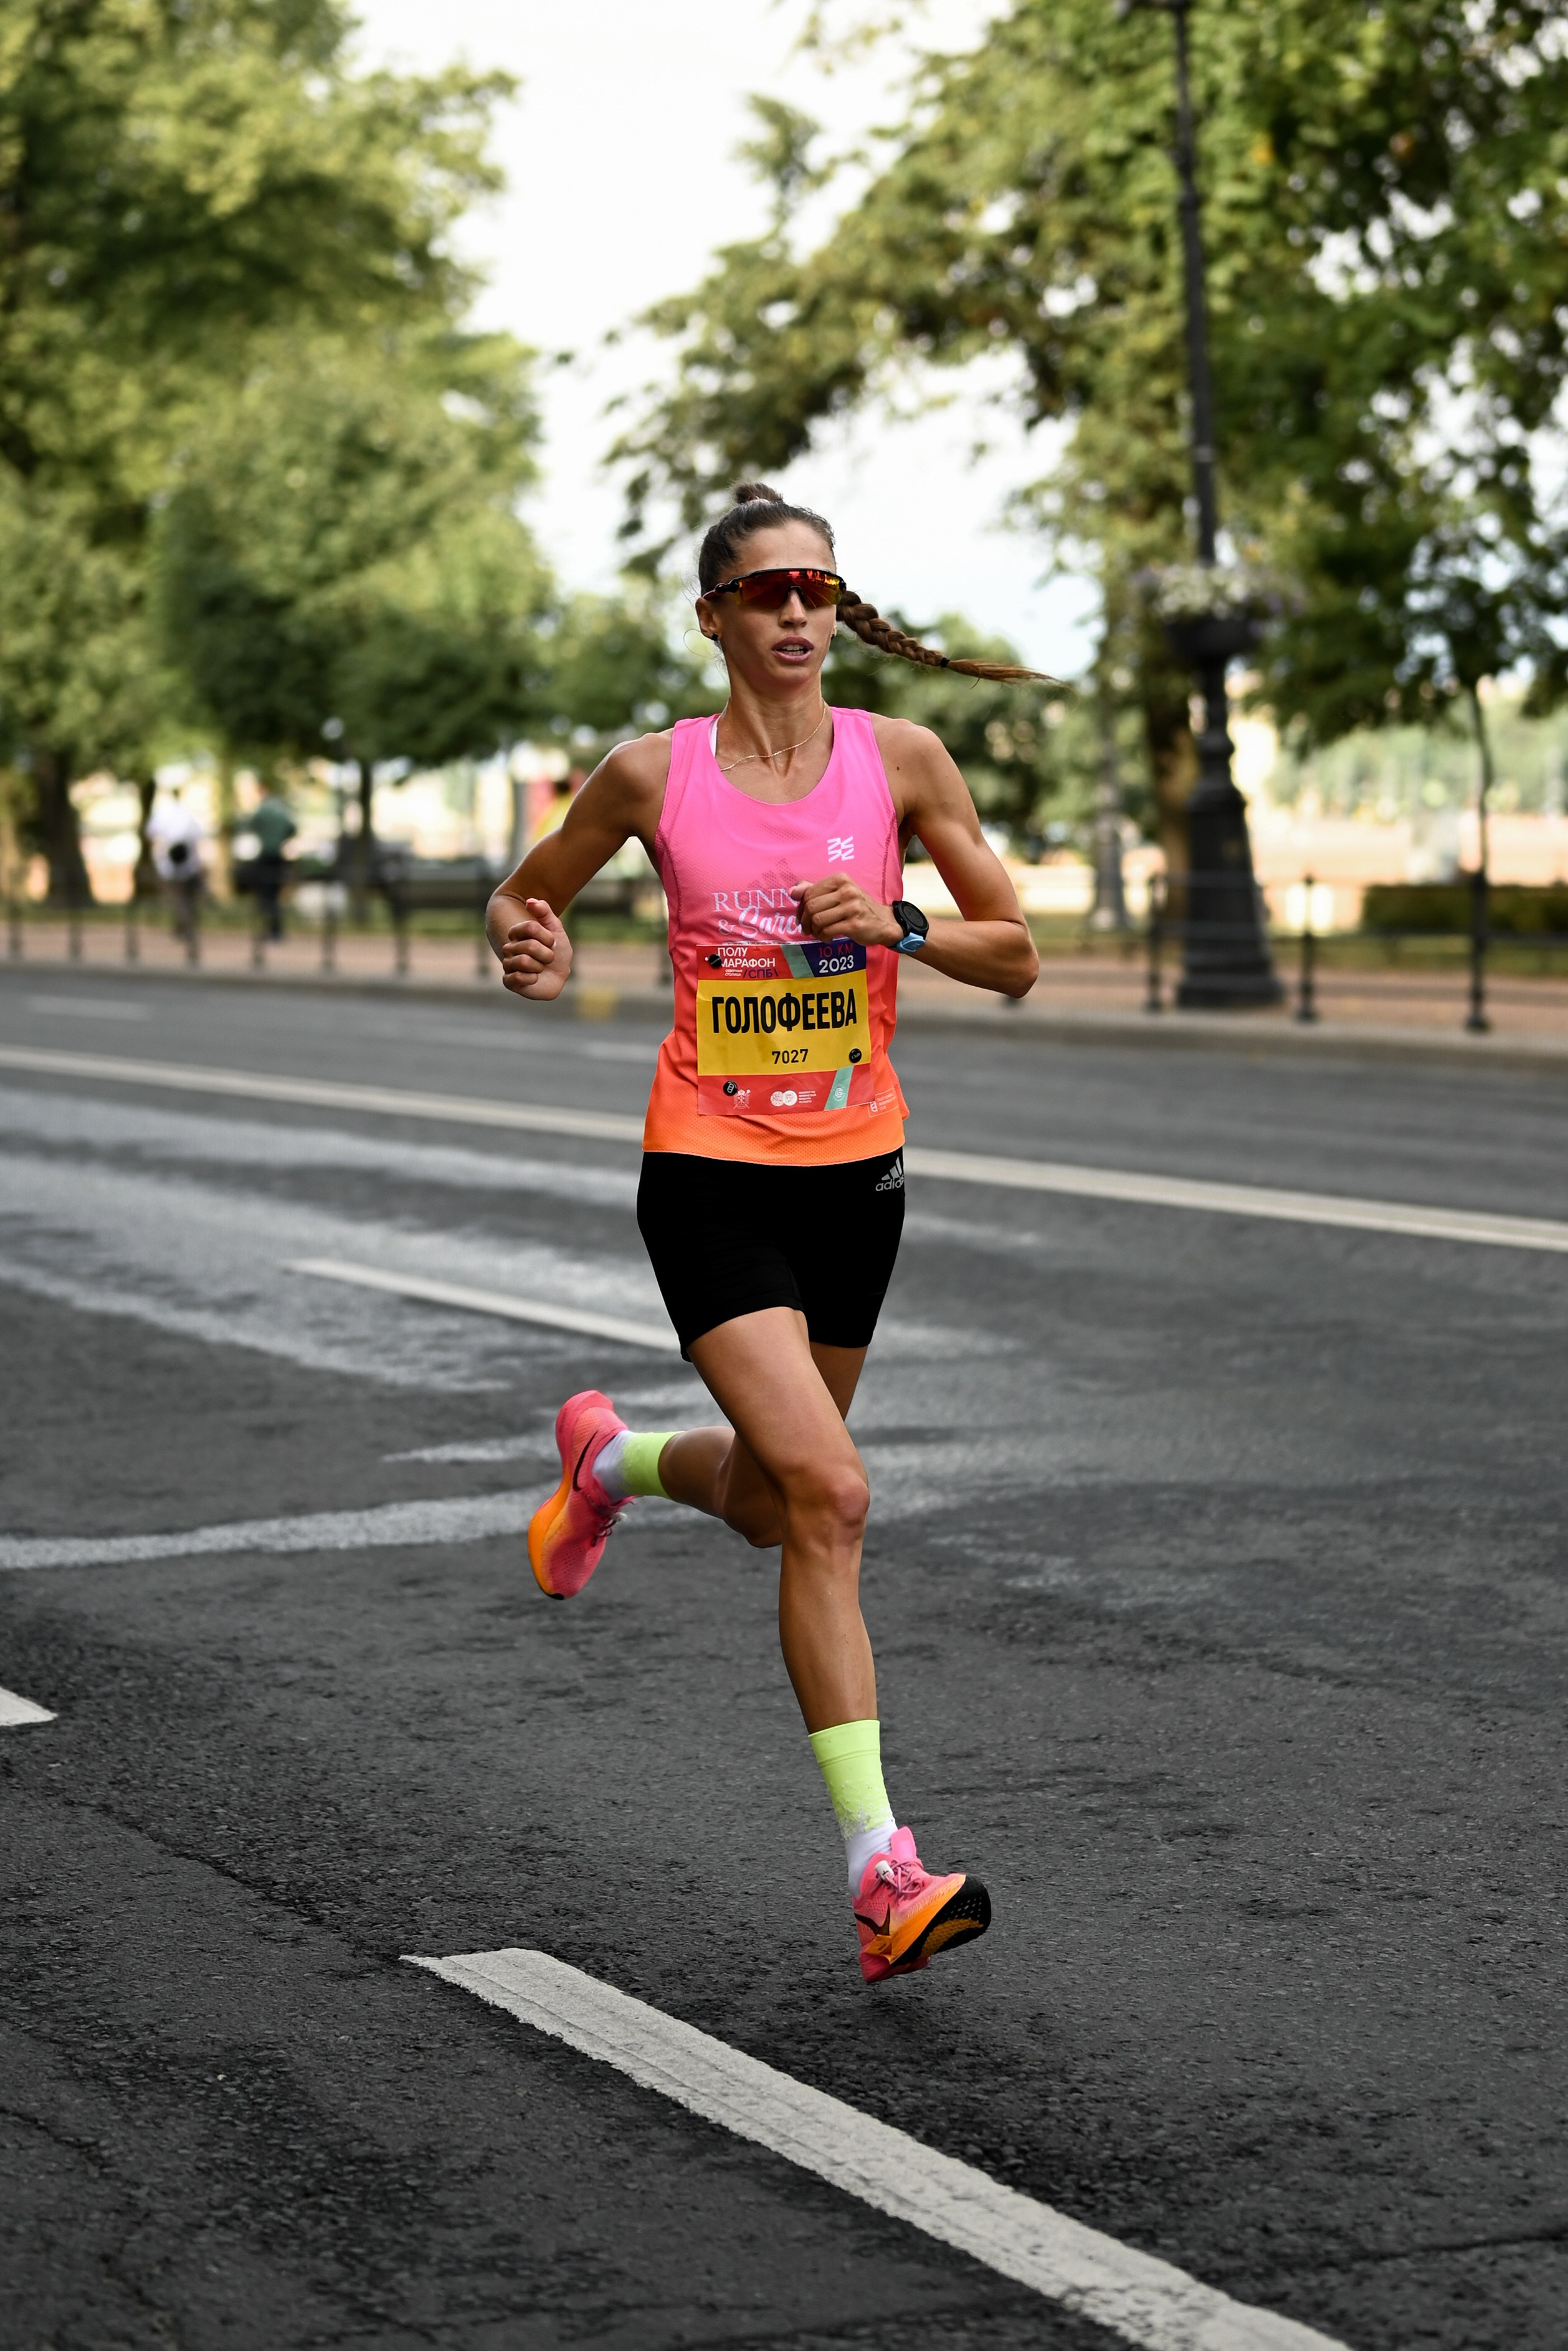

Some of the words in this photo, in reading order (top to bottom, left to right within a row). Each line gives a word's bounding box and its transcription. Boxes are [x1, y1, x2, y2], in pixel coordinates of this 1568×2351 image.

[712, 888, 799, 912] RUNN
[718, 919, 736, 934] &
[718, 947, 748, 957] ПОЛУ
[819, 946, 832, 957] 10
[819, 954, 854, 974] 2023
[711, 988, 857, 1034] ГОЛОФЕЕВА
[772, 1048, 809, 1065] 7027
